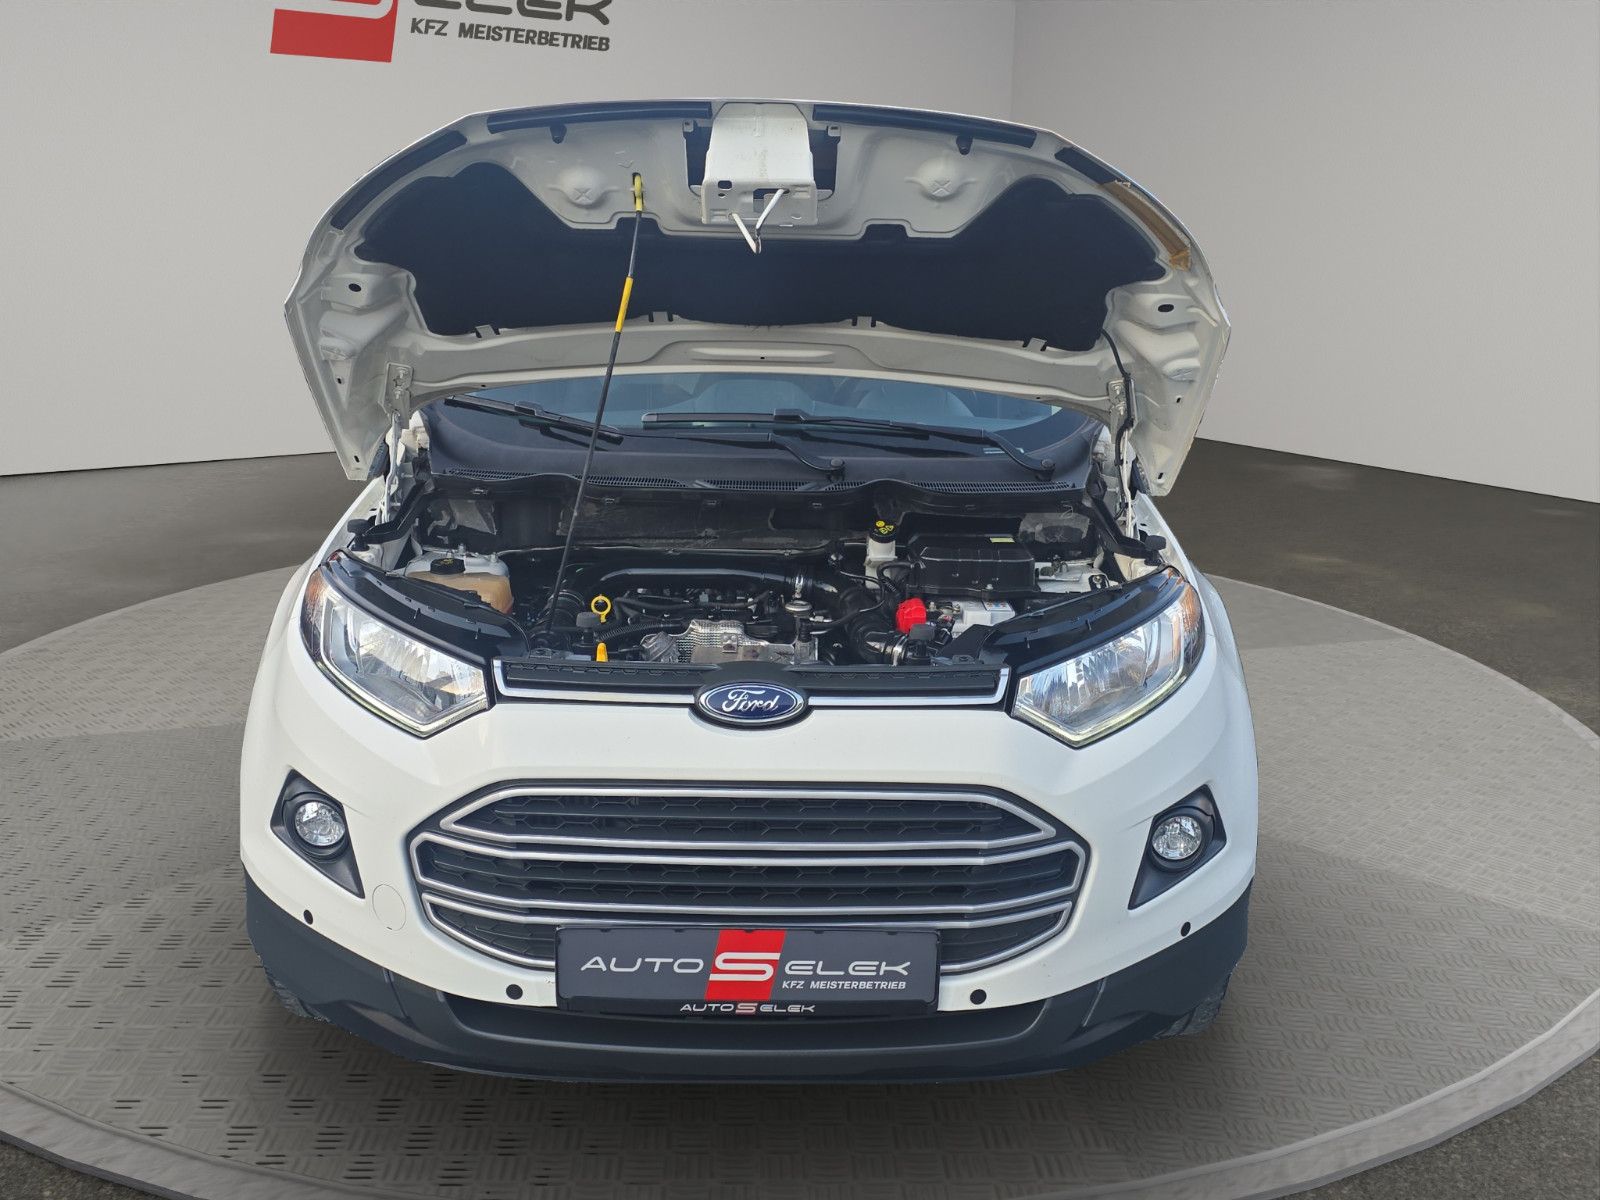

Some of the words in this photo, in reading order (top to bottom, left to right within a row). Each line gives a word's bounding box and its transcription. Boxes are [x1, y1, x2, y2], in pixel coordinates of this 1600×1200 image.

[410, 17, 449, 36] KFZ
[458, 22, 610, 51] MEISTERBETRIEB
[722, 689, 780, 712] Ford
[580, 956, 704, 974] AUTO
[782, 980, 805, 989] KFZ
[810, 981, 906, 990] MEISTERBETRIEB
[680, 1003, 734, 1012] AUTO
